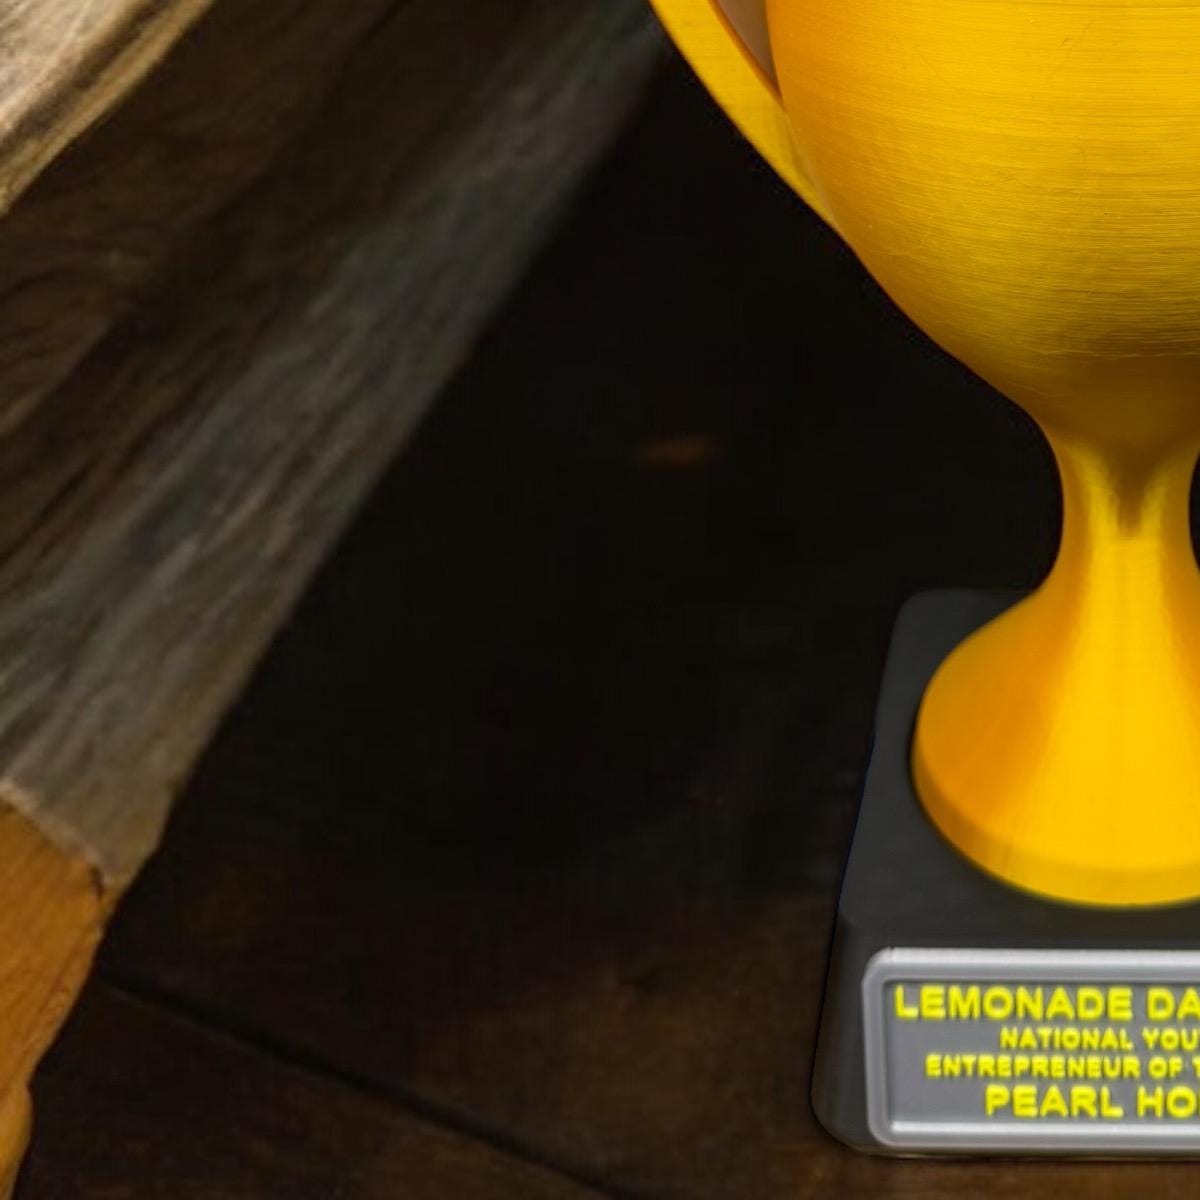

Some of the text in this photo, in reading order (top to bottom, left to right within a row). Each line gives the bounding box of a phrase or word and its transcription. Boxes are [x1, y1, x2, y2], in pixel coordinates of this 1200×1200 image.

[894, 984, 1133, 1023] LEMONADE
[998, 1026, 1134, 1052] NATIONAL
[924, 1052, 1142, 1080] ENTREPRENEUR
[1147, 1054, 1184, 1080] OF
[984, 1083, 1124, 1119] PEARL
